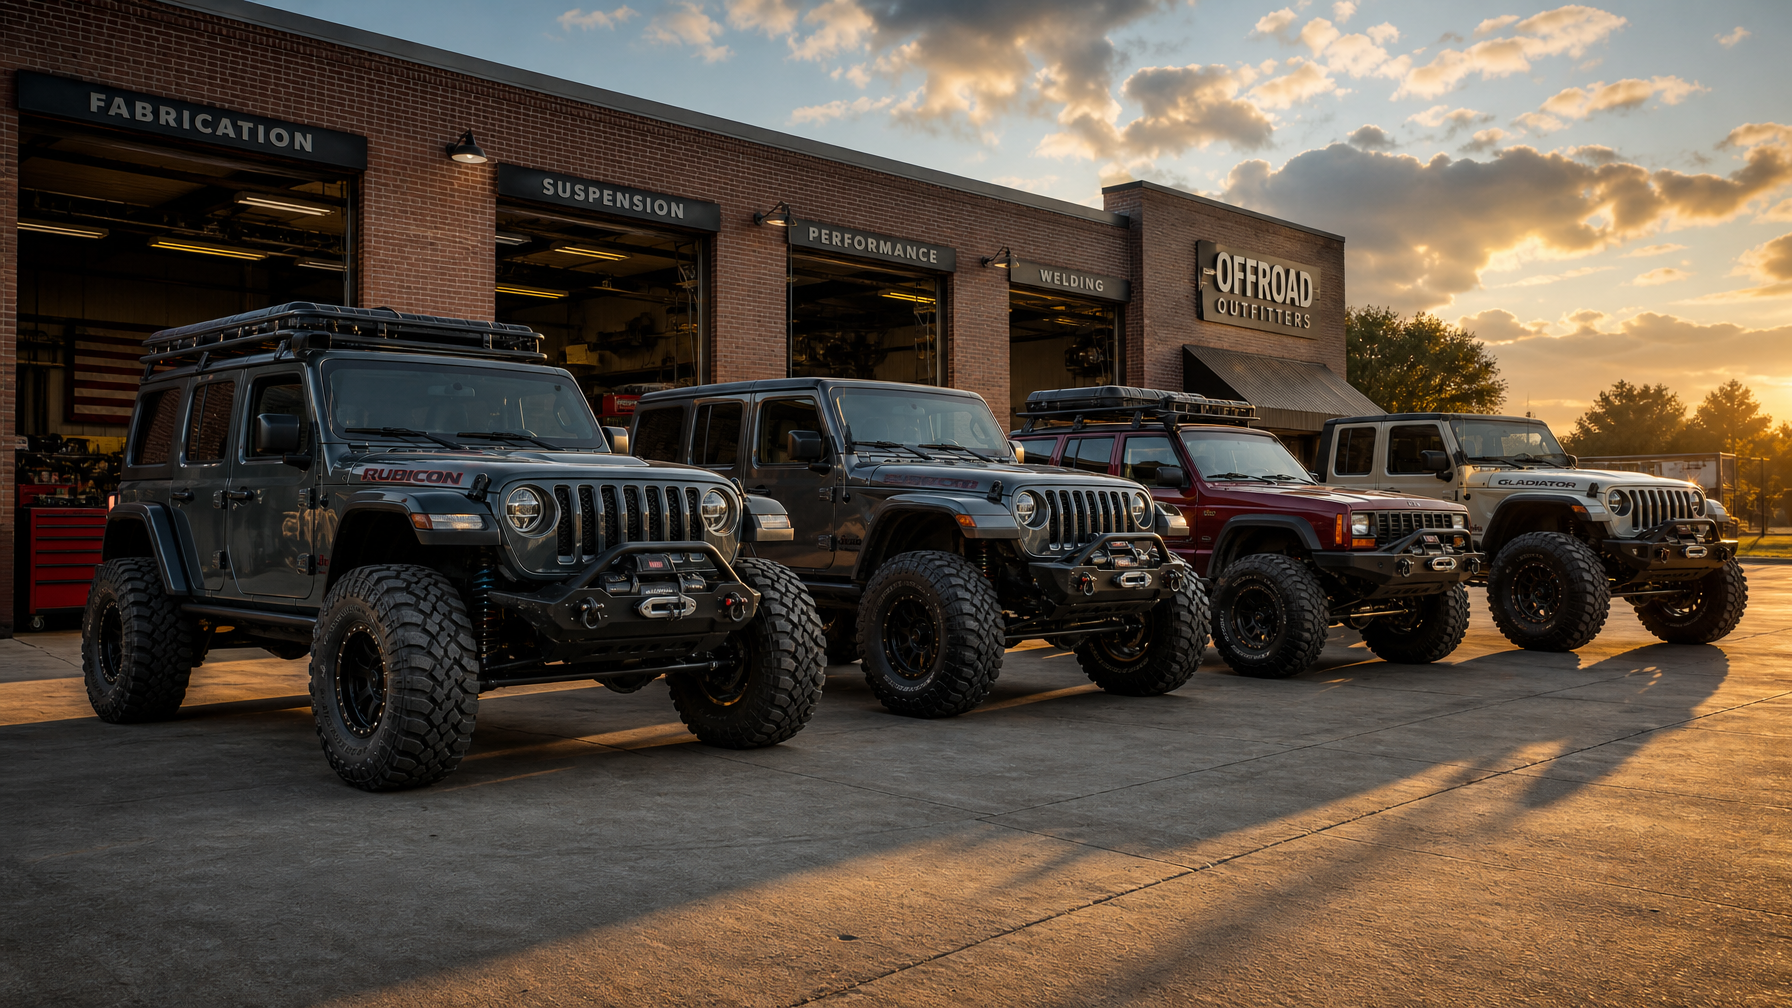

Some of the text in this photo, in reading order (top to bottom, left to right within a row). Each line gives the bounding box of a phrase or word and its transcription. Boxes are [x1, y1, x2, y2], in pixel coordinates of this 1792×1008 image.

[90, 92, 313, 153] FABRICATION
[542, 178, 684, 219] SUSPENSION
[808, 227, 938, 264] PERFORMANCE
[1040, 269, 1104, 292] WELDING
[1216, 252, 1313, 308] OFFROAD
[1217, 297, 1311, 329] OUTFITTERS
[361, 467, 464, 486] RUBICON
[1498, 479, 1577, 488] GLADIATOR
